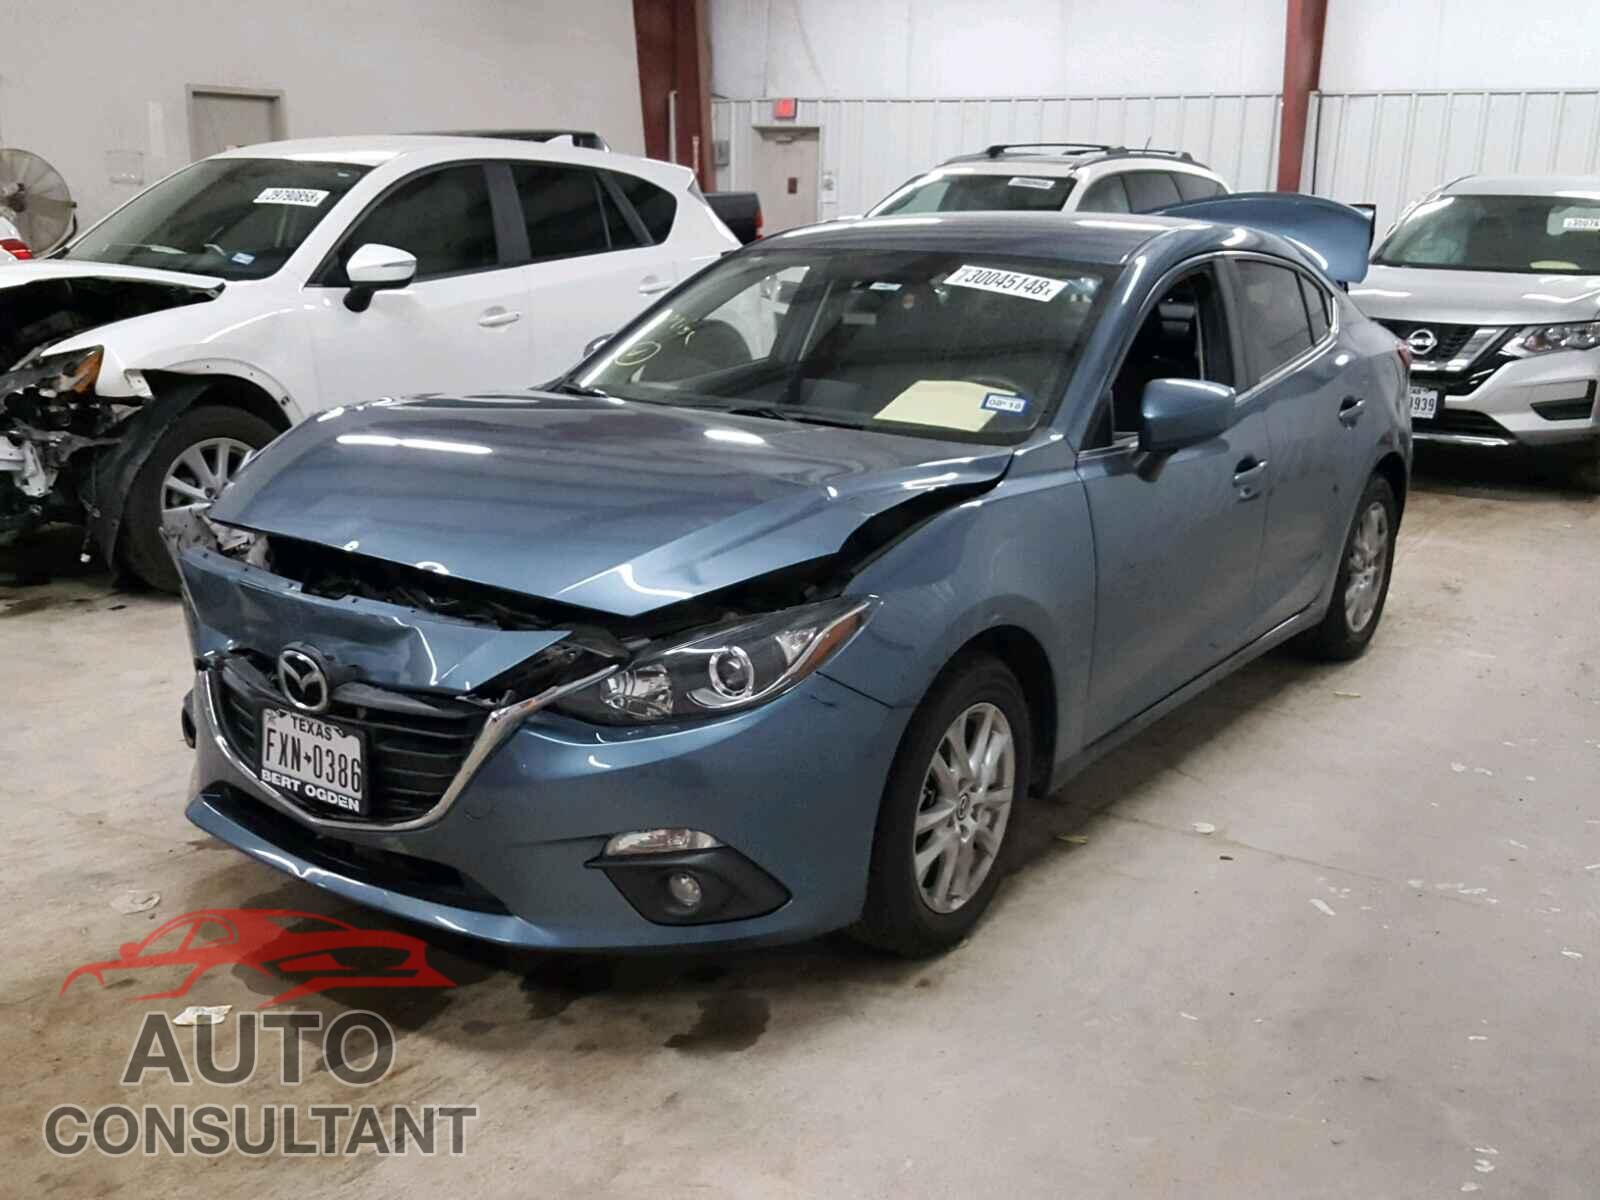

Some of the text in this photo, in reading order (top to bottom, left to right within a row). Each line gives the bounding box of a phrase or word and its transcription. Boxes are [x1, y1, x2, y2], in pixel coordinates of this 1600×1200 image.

[291, 716, 332, 741] TEXAS
[261, 768, 360, 813] BERT OGDEN
